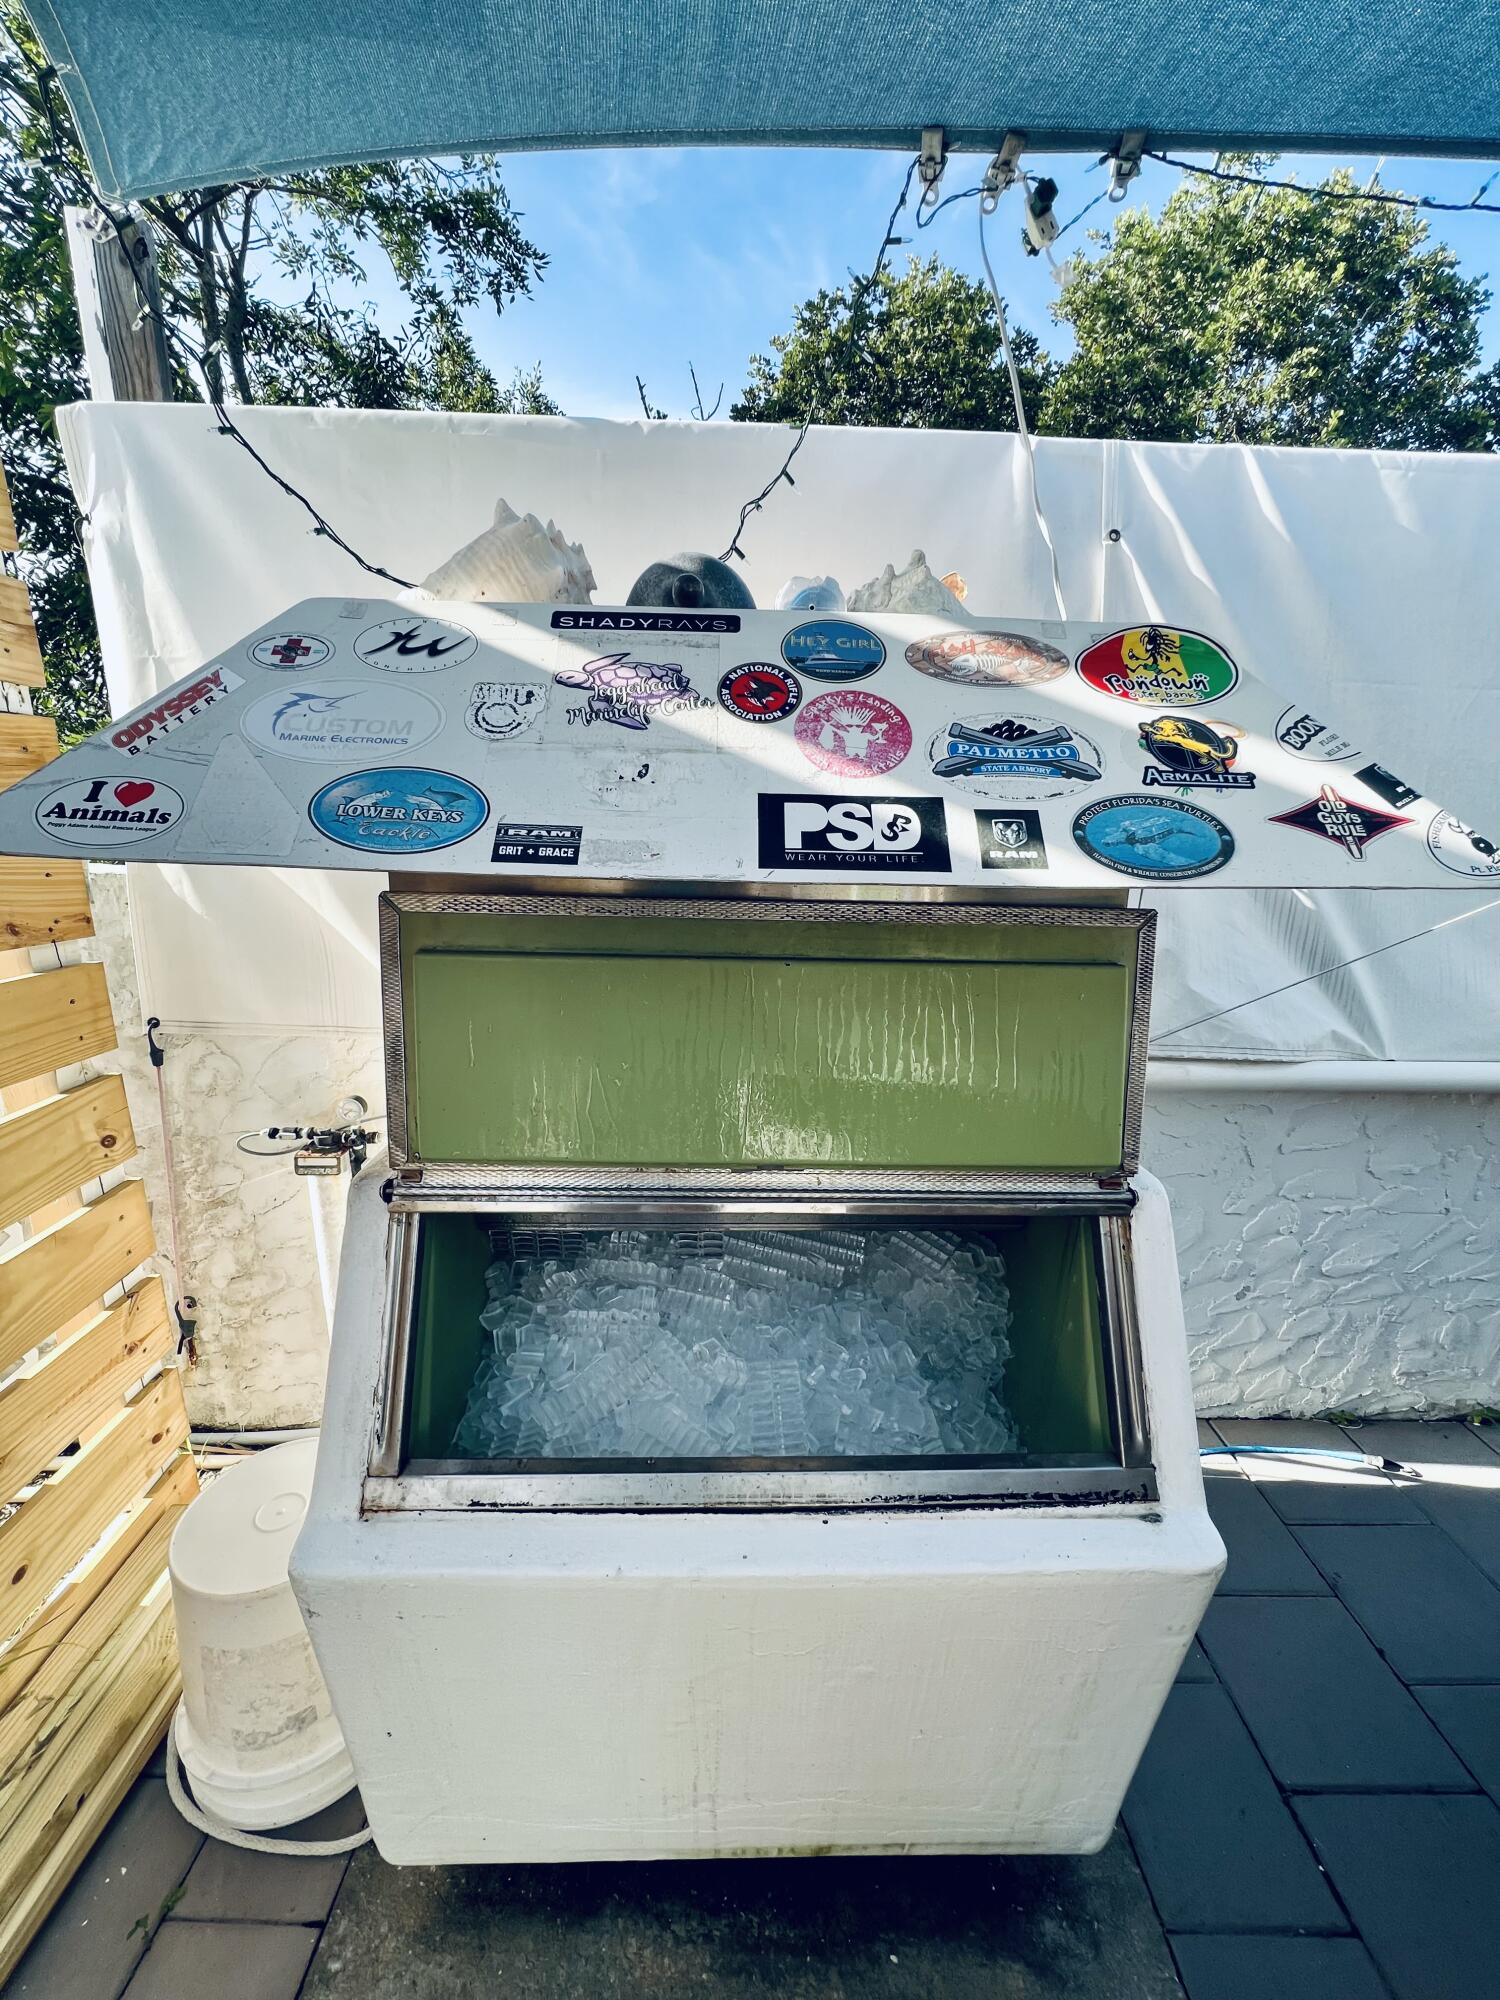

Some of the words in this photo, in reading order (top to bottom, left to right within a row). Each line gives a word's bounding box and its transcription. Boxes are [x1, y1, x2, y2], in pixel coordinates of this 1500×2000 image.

[559, 616, 727, 631] SHADYRAYS
[790, 634, 828, 647] HEY
[836, 637, 881, 651] GIRL
[591, 673, 680, 704] Loggerhead
[728, 664, 785, 680] NATIONAL
[785, 678, 798, 705] RIFLE
[1128, 691, 1160, 699] outer
[1163, 688, 1203, 700] banks
[112, 669, 223, 748] ODYSSEY
[660, 694, 717, 717] Center
[721, 688, 782, 720] ASSOCIATION
[858, 693, 902, 723] Landing
[127, 685, 229, 756] BATTERY
[283, 713, 414, 736] CUSTOM
[279, 732, 328, 743] MARINE
[331, 734, 409, 745] ELECTRONICS
[957, 743, 1071, 759] PALMETTO
[981, 765, 1010, 773] STATE
[1012, 765, 1052, 776] ARMORY
[83, 780, 108, 802] I
[42, 802, 172, 825] Animals
[336, 804, 406, 821] LOWER
[411, 808, 464, 823] KEYS
[1079, 802, 1112, 826] PROTECT
[1113, 797, 1161, 807] FLORIDA'S
[1162, 800, 1180, 808] SEA
[1182, 804, 1223, 831] TURTLES
[1318, 800, 1347, 812] OLD
[784, 802, 922, 851] PSD
[1317, 812, 1361, 823] GUYS
[507, 829, 571, 838] RAM
[1325, 823, 1367, 836] RULE
[498, 846, 523, 855] GRIT
[538, 847, 575, 857] GRACE
[785, 853, 827, 861] WEAR
[835, 854, 878, 863] YOUR
[989, 851, 1039, 859] RAM
